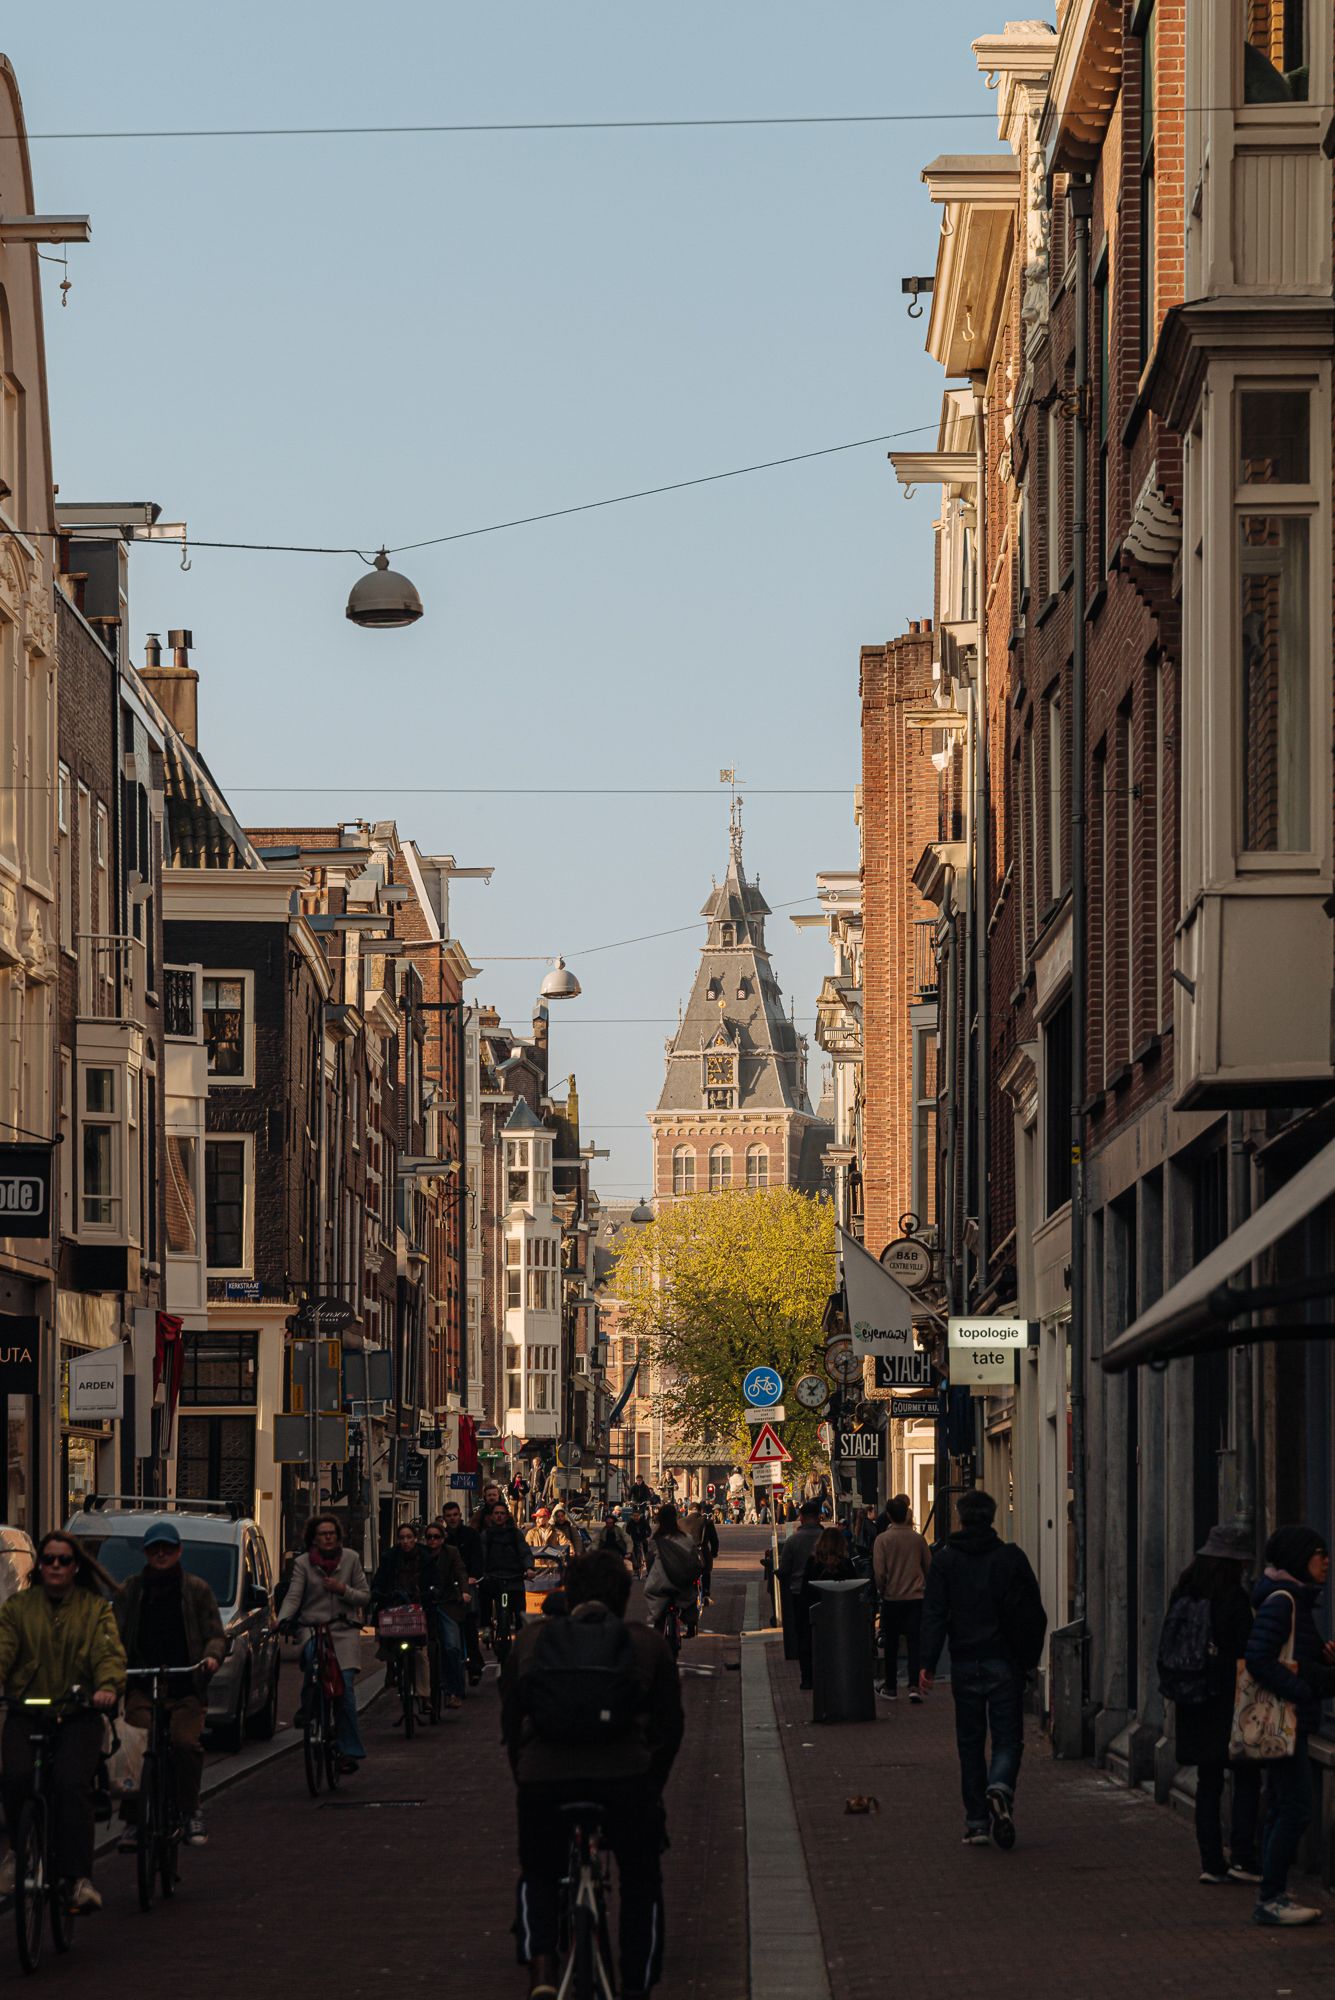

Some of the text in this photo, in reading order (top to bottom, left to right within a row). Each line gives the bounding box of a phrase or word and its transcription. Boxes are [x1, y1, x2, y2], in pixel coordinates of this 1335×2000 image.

[896, 1251, 918, 1261] B&B
[910, 1263, 923, 1271] VILLE
[228, 1282, 260, 1290] KERKSTRAAT
[862, 1328, 908, 1344] eyemazy
[958, 1327, 1019, 1341] topologie
[972, 1351, 1005, 1365] tate
[883, 1353, 931, 1382] STACH
[78, 1381, 115, 1391] ARDEN
[893, 1402, 926, 1414] GOURMET
[840, 1433, 879, 1456] STACH
